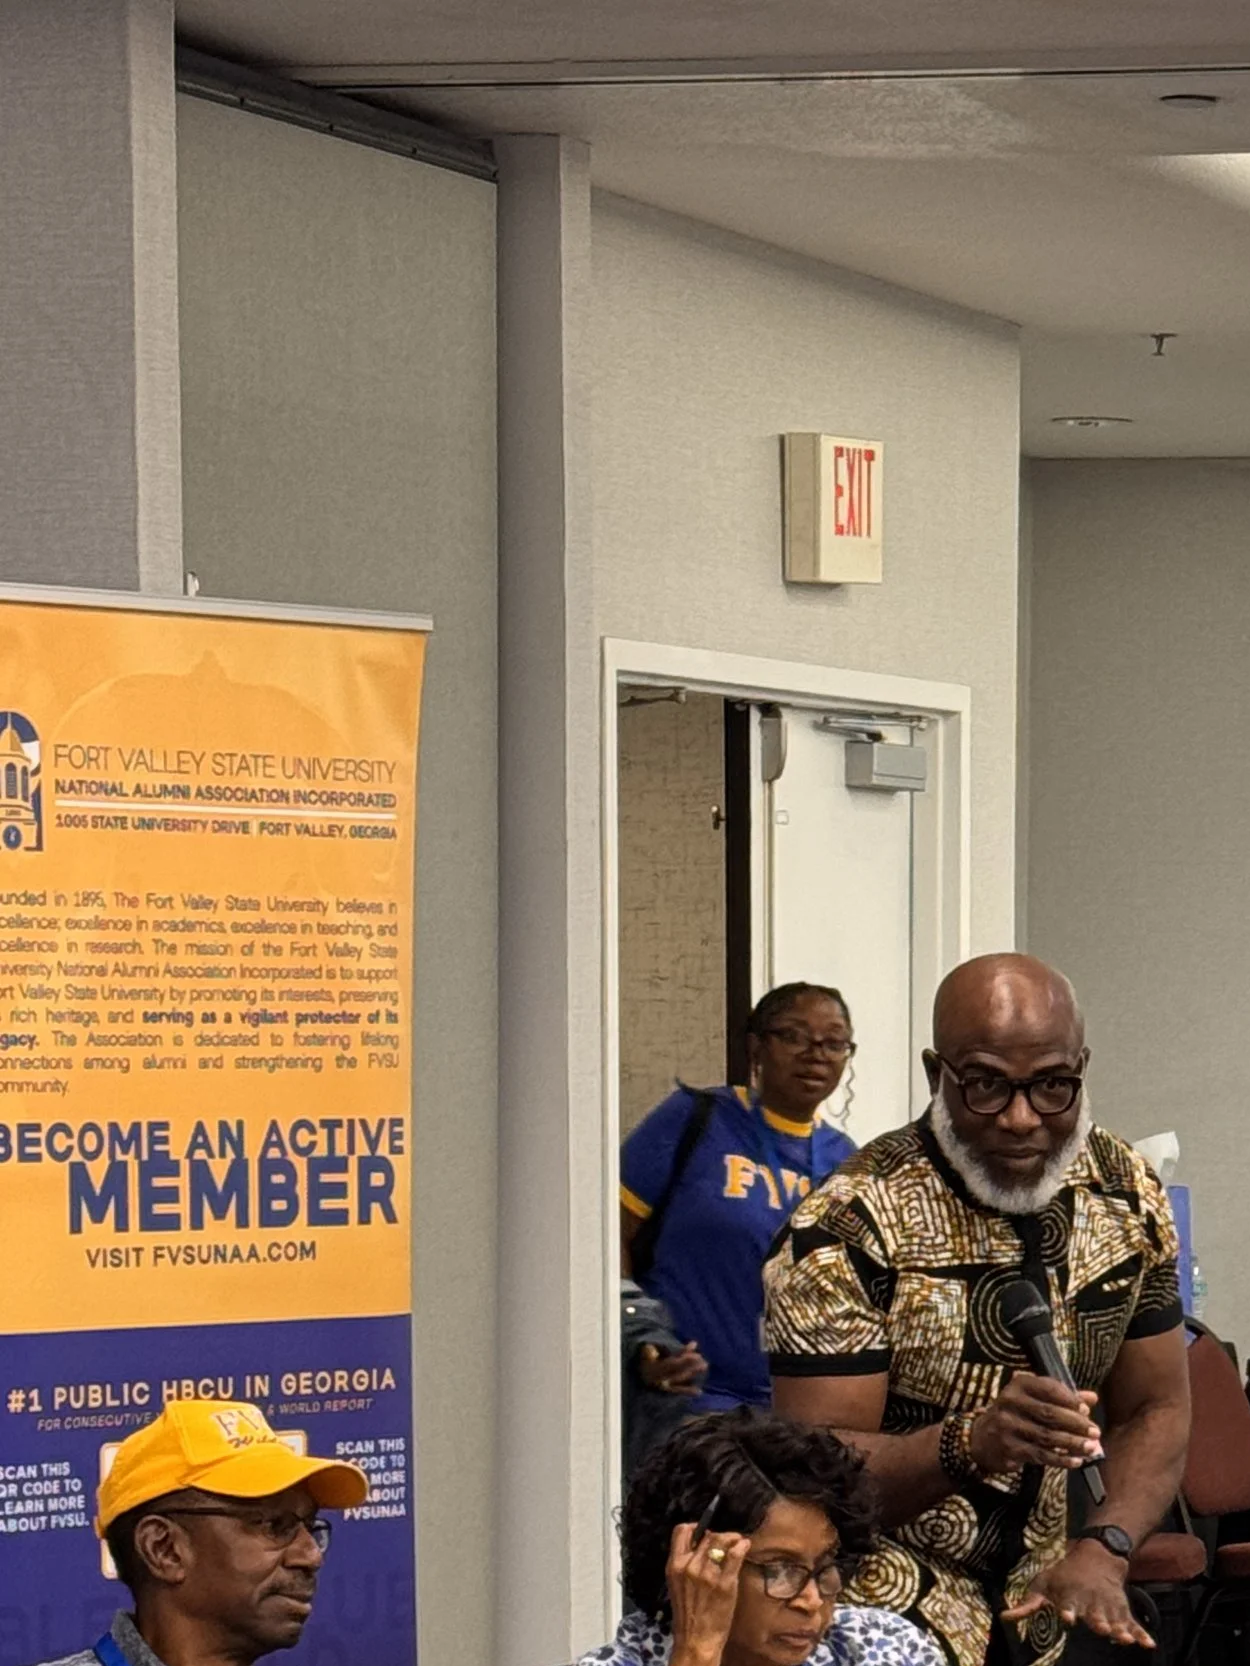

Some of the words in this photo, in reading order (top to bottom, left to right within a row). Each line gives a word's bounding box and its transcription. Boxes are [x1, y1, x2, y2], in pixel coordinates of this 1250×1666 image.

[834, 446, 875, 538] EXIT
[54, 744, 112, 771] FORT
[118, 747, 206, 775] VALLEY
[211, 751, 276, 779] STATE
[281, 756, 397, 784] UNIVERSITY
[54, 778, 129, 798] NATIONAL
[133, 783, 191, 800] ALUMNI
[194, 784, 289, 804] ASSOCIATION
[293, 789, 397, 809] INCORPORATED
[55, 813, 89, 829] 1005
[91, 815, 128, 831] STATE
[131, 817, 209, 834] UNIVERSITY
[211, 819, 250, 835] DRIVE
[259, 821, 292, 836] FORT
[350, 825, 397, 840] GEORGIA
[54, 891, 68, 907] in
[113, 891, 140, 908] The
[146, 892, 174, 909] Fort
[180, 892, 218, 914] Valley
[225, 895, 261, 911] State
[267, 896, 329, 916] University
[336, 897, 383, 914] believes
[388, 898, 397, 914] in
[65, 915, 132, 932] excellence
[136, 915, 148, 932] in
[231, 918, 297, 935] excellence
[301, 919, 312, 935] in
[377, 922, 398, 936] and
[67, 938, 78, 953] in
[152, 938, 177, 955] The
[185, 940, 233, 956] mission
[240, 940, 255, 957] of
[262, 941, 283, 957] the
[290, 941, 318, 957] Fort
[324, 941, 363, 962] Valley
[369, 943, 398, 958] State
[57, 960, 108, 977] National
[111, 961, 160, 978] Alumni
[162, 962, 236, 979] Association
[240, 963, 323, 983] Incorporated
[326, 964, 336, 980] is
[340, 965, 353, 980] to
[356, 966, 397, 984] support
[19, 983, 61, 1003] Valley
[65, 983, 97, 1000] State
[100, 984, 164, 1005] University
[169, 985, 186, 1005] by
[189, 987, 257, 1006] promoting
[260, 987, 275, 1001] its
[339, 989, 399, 1006] preserving
[10, 1007, 37, 1023] rich
[107, 1008, 134, 1024] and
[142, 1008, 194, 1028] serving
[201, 1010, 217, 1024] as
[223, 1010, 232, 1024] a
[239, 1008, 289, 1028] vigilant
[295, 1009, 361, 1028] protector
[367, 1008, 380, 1024] of
[385, 1008, 399, 1024] its
[51, 1030, 77, 1047] The
[86, 1031, 163, 1047] Association
[173, 1032, 183, 1047] is
[194, 1032, 259, 1047] dedicated
[270, 1032, 284, 1047] to
[293, 1032, 351, 1050] fostering
[360, 1031, 399, 1050] lifelong
[83, 1056, 131, 1074] among
[142, 1054, 187, 1070] alumni
[198, 1054, 224, 1070] and
[234, 1054, 323, 1073] strengthening
[335, 1054, 357, 1069] the
[368, 1053, 399, 1069] FVSU
[185, 1119, 244, 1159] AN
[258, 1117, 404, 1160] ACTIVE
[69, 1155, 398, 1234] MEMBER
[86, 1247, 145, 1269] VISIT
[153, 1241, 316, 1267] FVSUNAA.COM
[7, 1388, 43, 1413] #1
[54, 1381, 150, 1410] PUBLIC
[161, 1376, 234, 1402] HBCU
[245, 1374, 269, 1398] IN
[280, 1367, 396, 1395] GEORGIA
[37, 1417, 61, 1431] FOR
[64, 1412, 151, 1430] CONSECUTIVE
[279, 1401, 320, 1415] WORLD
[324, 1398, 373, 1412] REPORT
[336, 1440, 375, 1455] SCAN
[378, 1437, 405, 1452] THIS
[41, 1462, 70, 1476] THIS
[390, 1454, 405, 1467] TO
[22, 1480, 60, 1496] CODE
[63, 1478, 82, 1492] TO
[370, 1470, 406, 1485] MORE
[47, 1495, 86, 1511] MORE
[50, 1512, 90, 1529] FVSU.
